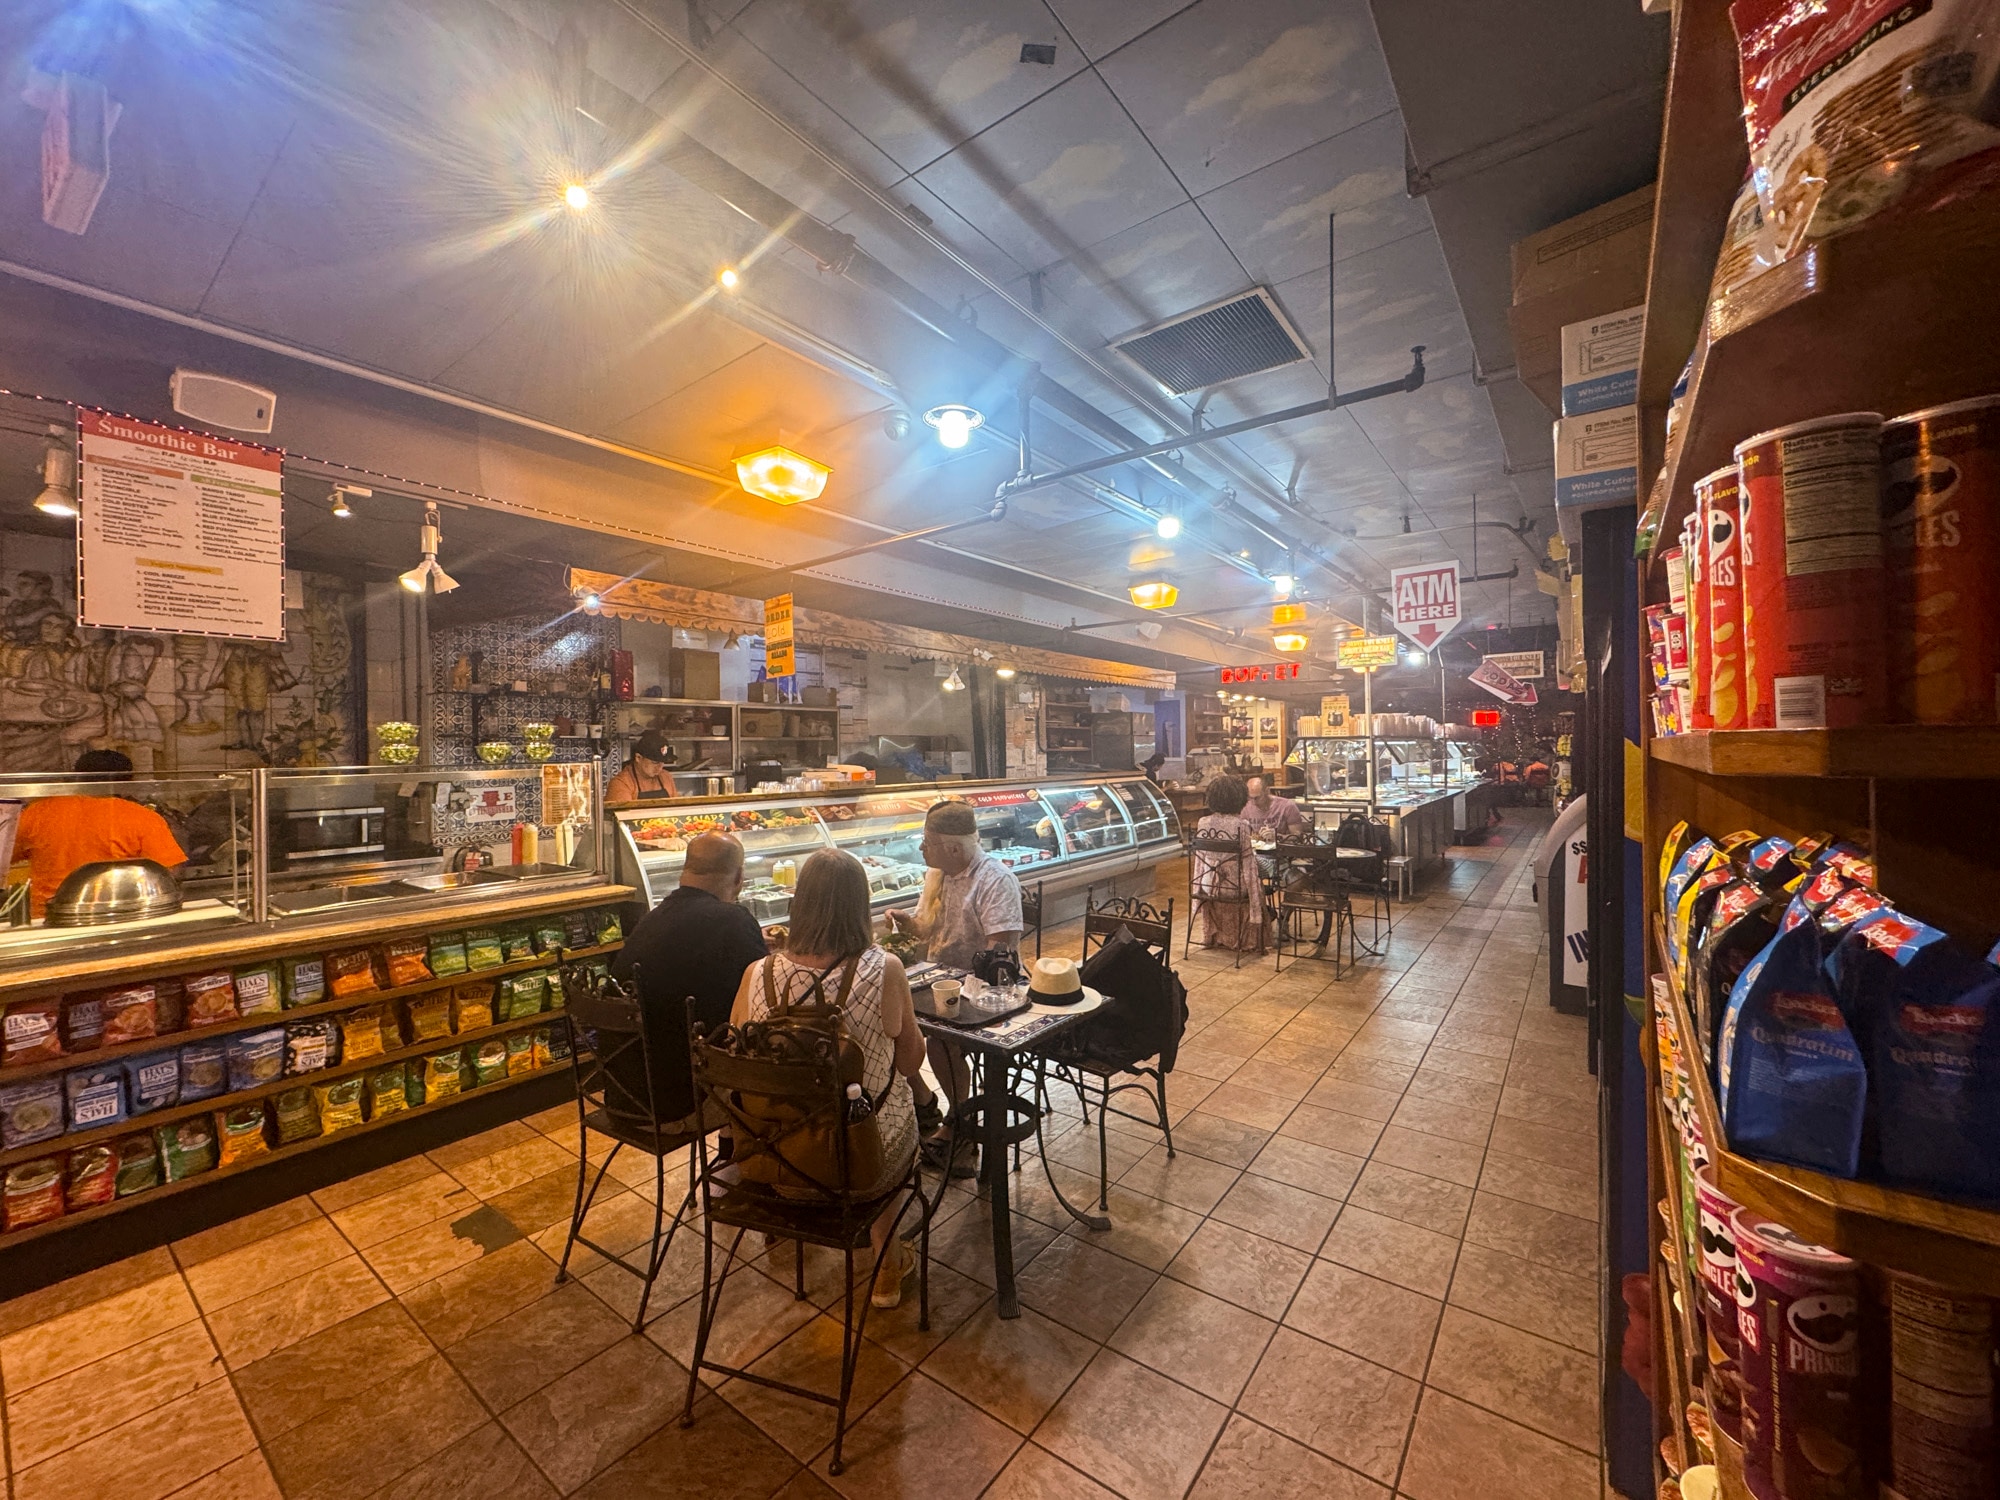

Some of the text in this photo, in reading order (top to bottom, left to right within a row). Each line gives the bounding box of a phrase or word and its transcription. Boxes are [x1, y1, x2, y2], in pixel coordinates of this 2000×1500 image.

[1791, 7, 1914, 103] EVERYTHING
[1578, 382, 1608, 398] White
[97, 420, 237, 461] Smoothie Bar
[101, 467, 124, 476] SUPER
[125, 471, 149, 481] POWER
[101, 482, 141, 494] INVINCIBLE
[1571, 481, 1601, 492] White
[225, 490, 245, 499] TANGO
[101, 497, 120, 505] COLD
[201, 512, 218, 520] BLUE
[228, 506, 247, 514] BLAST
[215, 525, 238, 534] FUSION
[202, 534, 239, 545] DELIGHTFUL
[202, 545, 232, 554] TROPICAL
[161, 572, 185, 580] BREEZE
[143, 581, 173, 590] TROPICAL
[1398, 572, 1455, 609] ATM
[143, 592, 165, 600] TRIPLE
[166, 594, 187, 602] BERRY
[187, 596, 220, 605] SENSATION
[168, 606, 194, 614] BERRIES
[766, 608, 790, 623] ORDER
[1400, 603, 1455, 621] HERE
[1481, 667, 1524, 695] SODAS
[978, 792, 1026, 803] COLD SANDWICHES
[685, 812, 725, 823] SALADS
[240, 976, 267, 992] HAL'S
[513, 978, 544, 994] KETTLE
[1750, 1026, 1854, 1062] Quadratini
[143, 1064, 175, 1080] HAL'S
[80, 1102, 114, 1120] HAL'S
